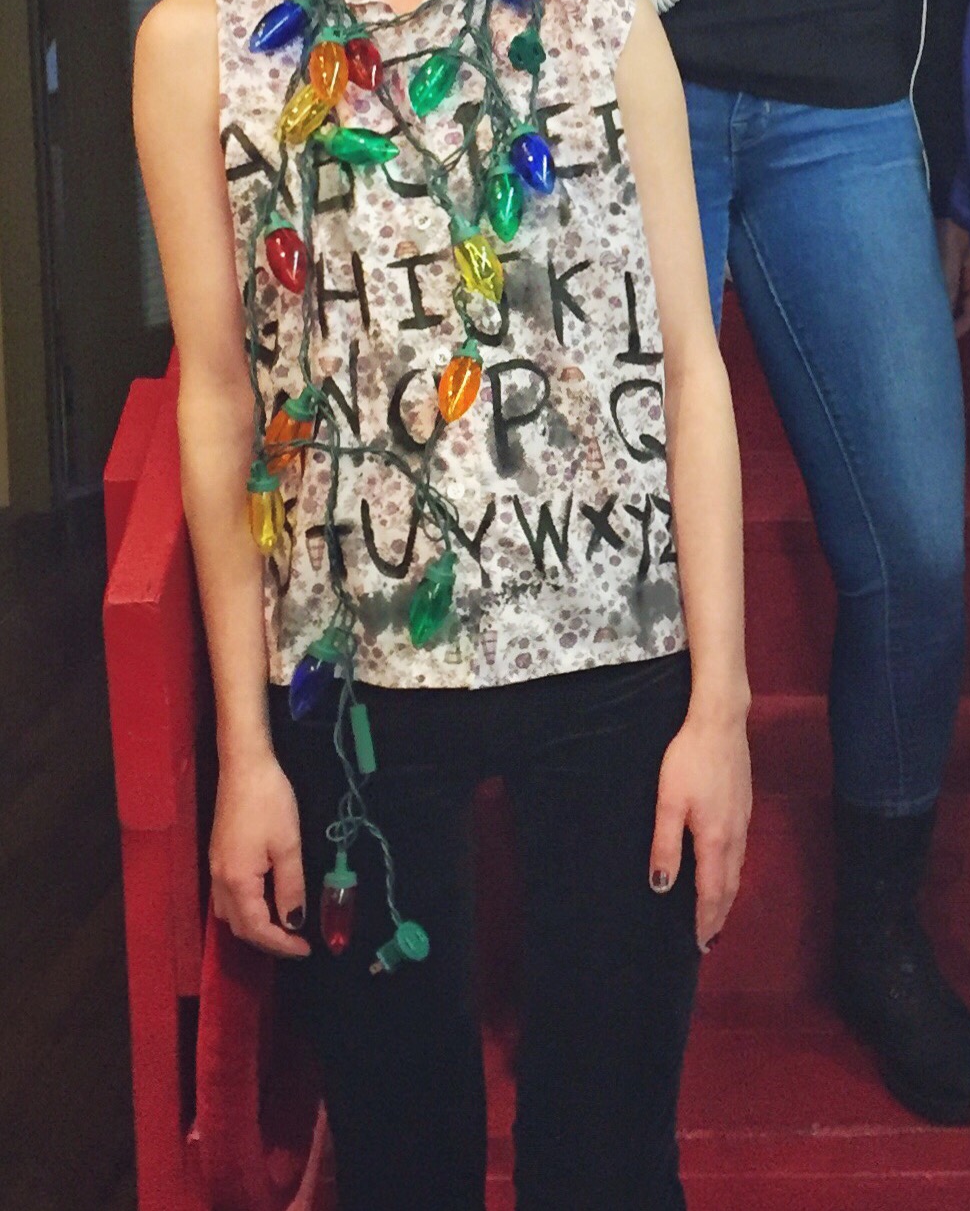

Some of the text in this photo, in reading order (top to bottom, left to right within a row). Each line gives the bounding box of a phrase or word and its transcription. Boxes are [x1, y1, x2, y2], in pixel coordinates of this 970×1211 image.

[314, 250, 371, 340] H
[386, 252, 445, 331] I
[547, 251, 593, 346] K
[614, 270, 665, 365] L
[485, 358, 551, 478] P
[359, 494, 420, 580] U
[512, 491, 576, 579] W
[579, 493, 625, 562] X
